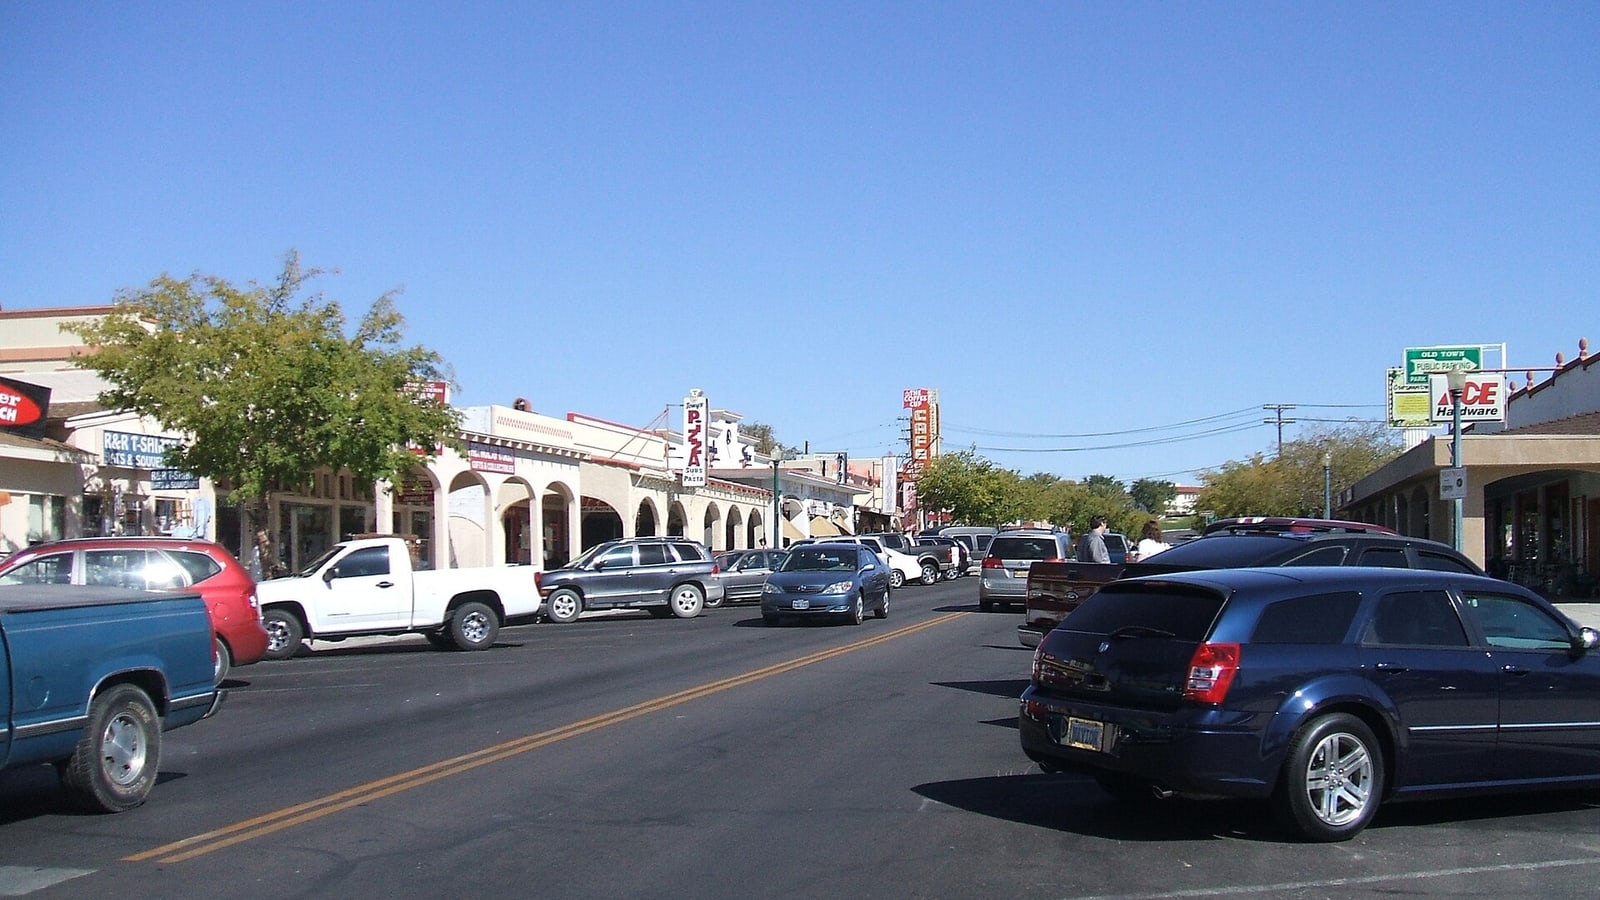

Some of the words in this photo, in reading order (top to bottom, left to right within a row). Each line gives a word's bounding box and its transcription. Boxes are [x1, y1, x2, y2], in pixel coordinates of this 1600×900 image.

[1416, 362, 1440, 371] PUBLIC
[1436, 406, 1498, 417] Hadware
[104, 432, 129, 451] R&R
[688, 410, 702, 466] PIZZA
[127, 454, 134, 466] &
